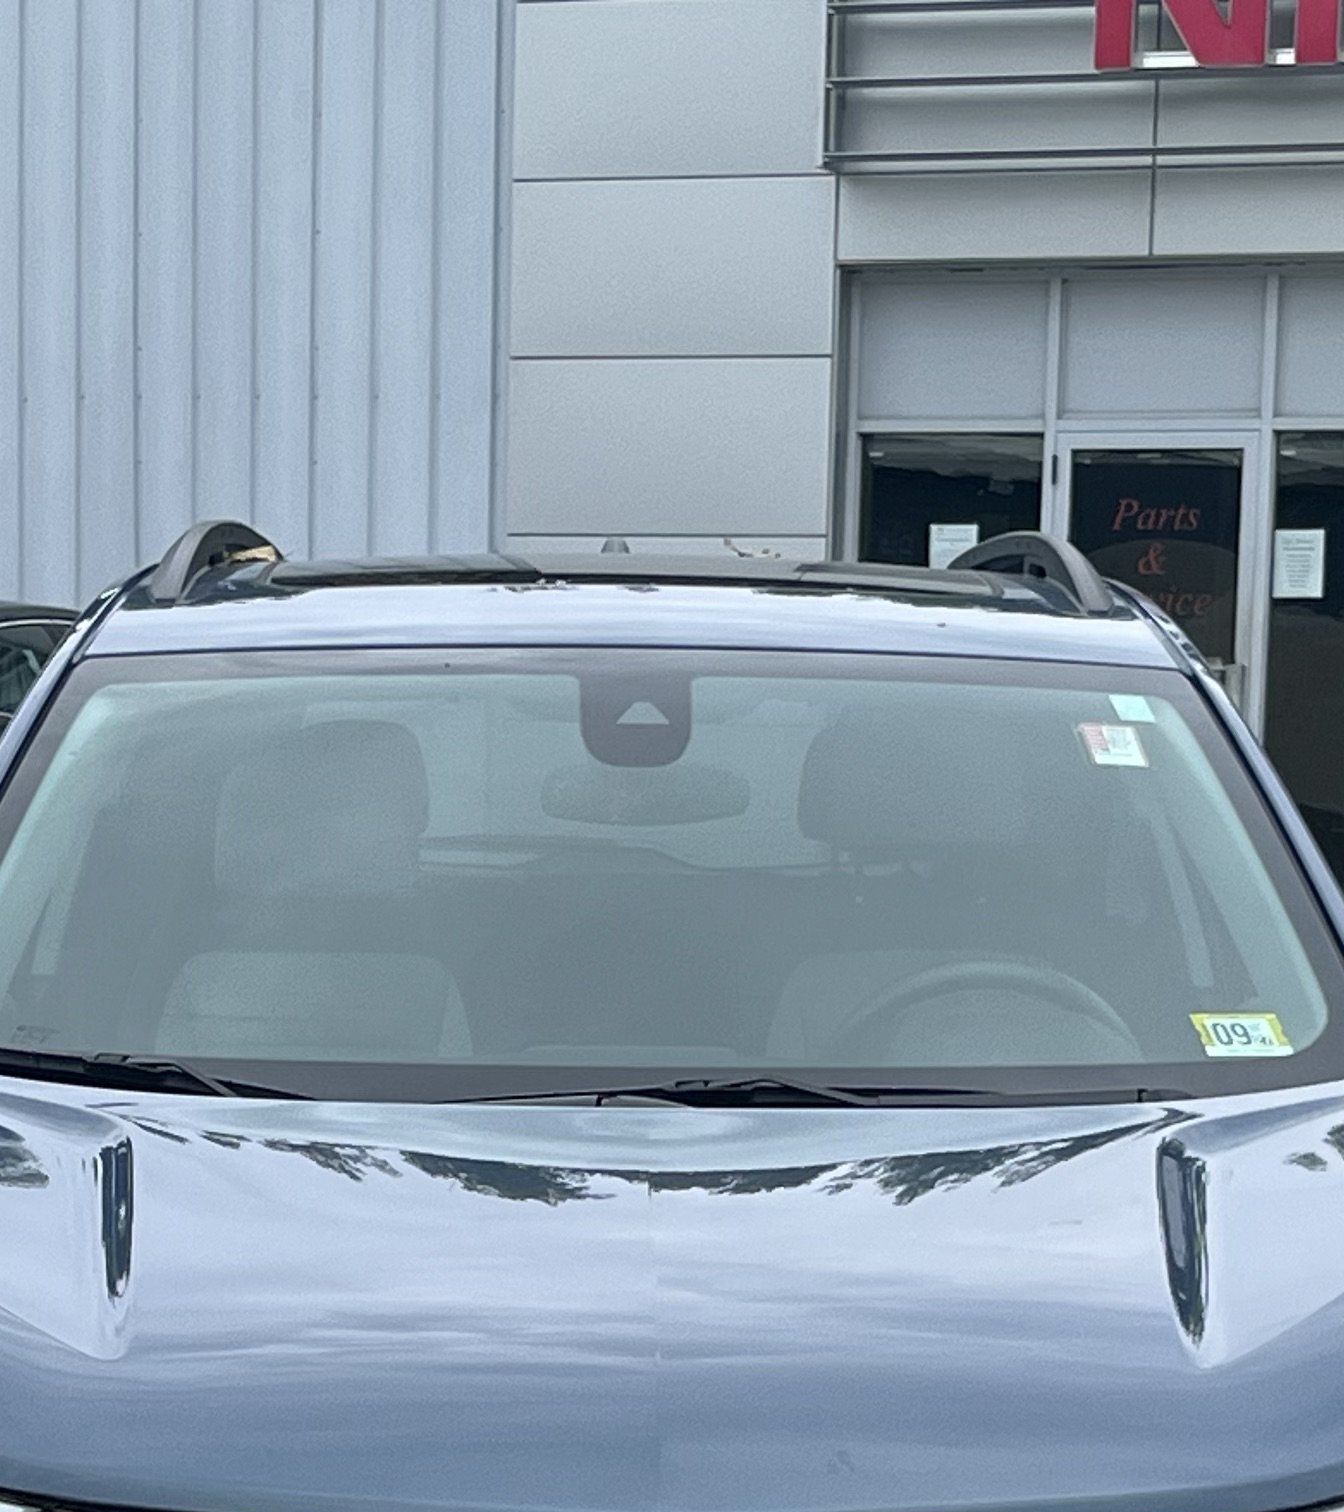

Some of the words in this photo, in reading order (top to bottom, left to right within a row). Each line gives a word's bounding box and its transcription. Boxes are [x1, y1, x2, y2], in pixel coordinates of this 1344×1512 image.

[1112, 498, 1201, 531] Parts
[1138, 541, 1166, 575] &
[1212, 1023, 1252, 1046] 09
